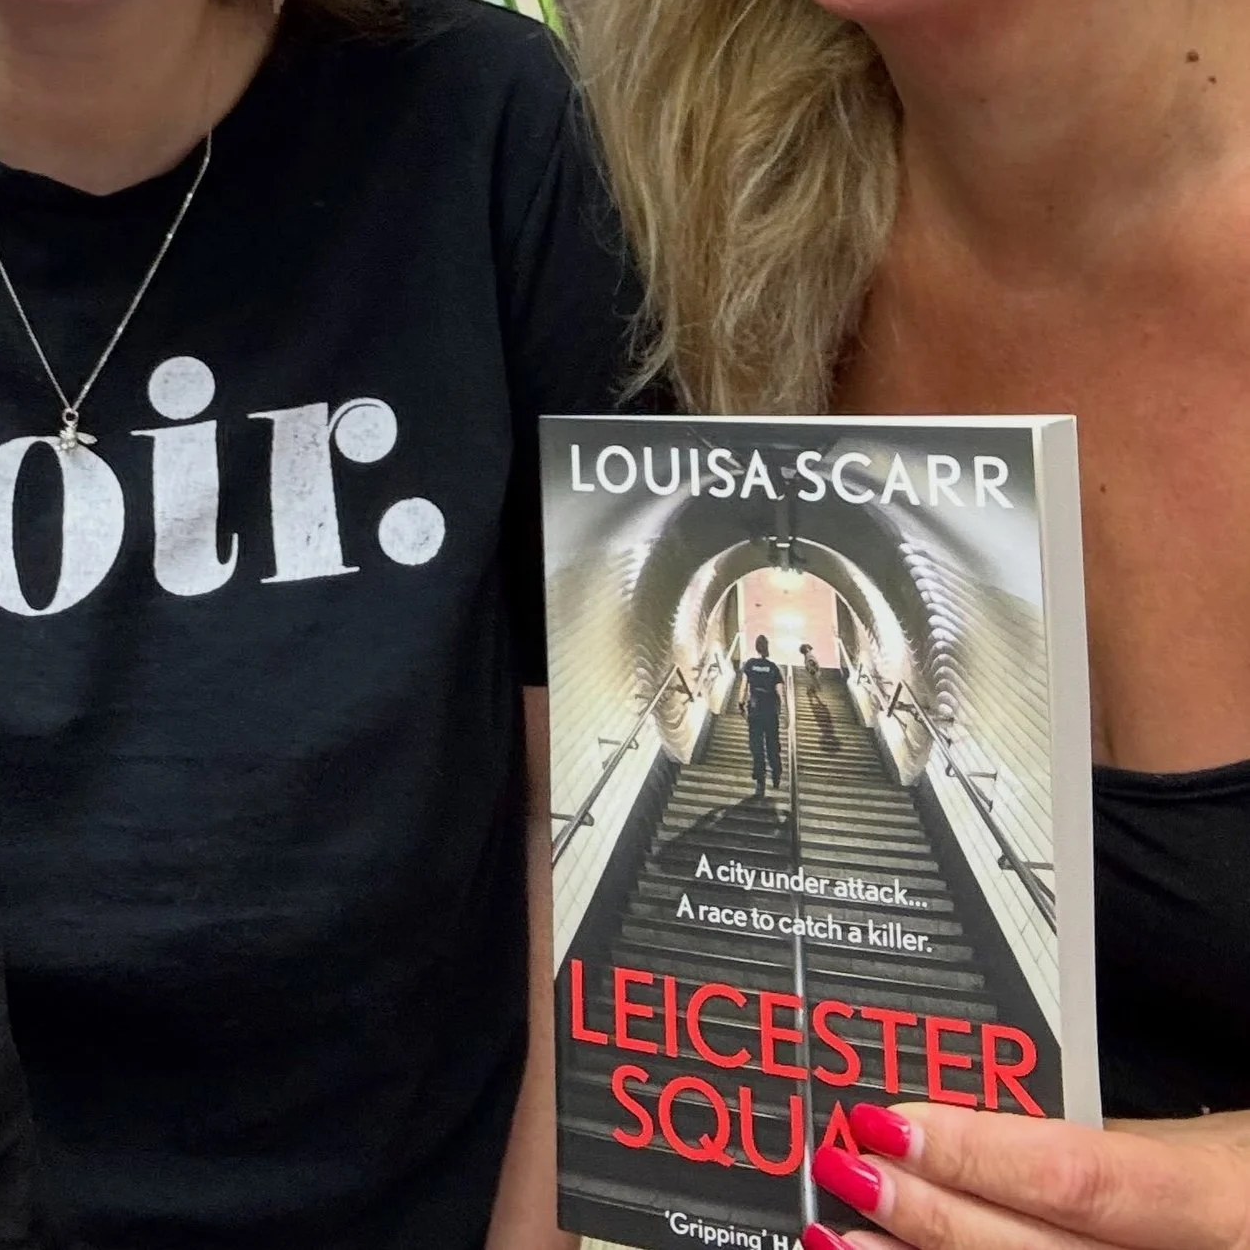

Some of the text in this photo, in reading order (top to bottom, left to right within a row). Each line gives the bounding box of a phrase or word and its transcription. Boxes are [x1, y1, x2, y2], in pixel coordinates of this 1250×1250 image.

[569, 443, 1015, 510] LOUISA SCARR
[695, 853, 929, 909] A city under attack...
[675, 894, 934, 954] A race to catch a killer.
[570, 958, 1046, 1119] LEICESTER
[612, 1064, 862, 1176] SQUA
